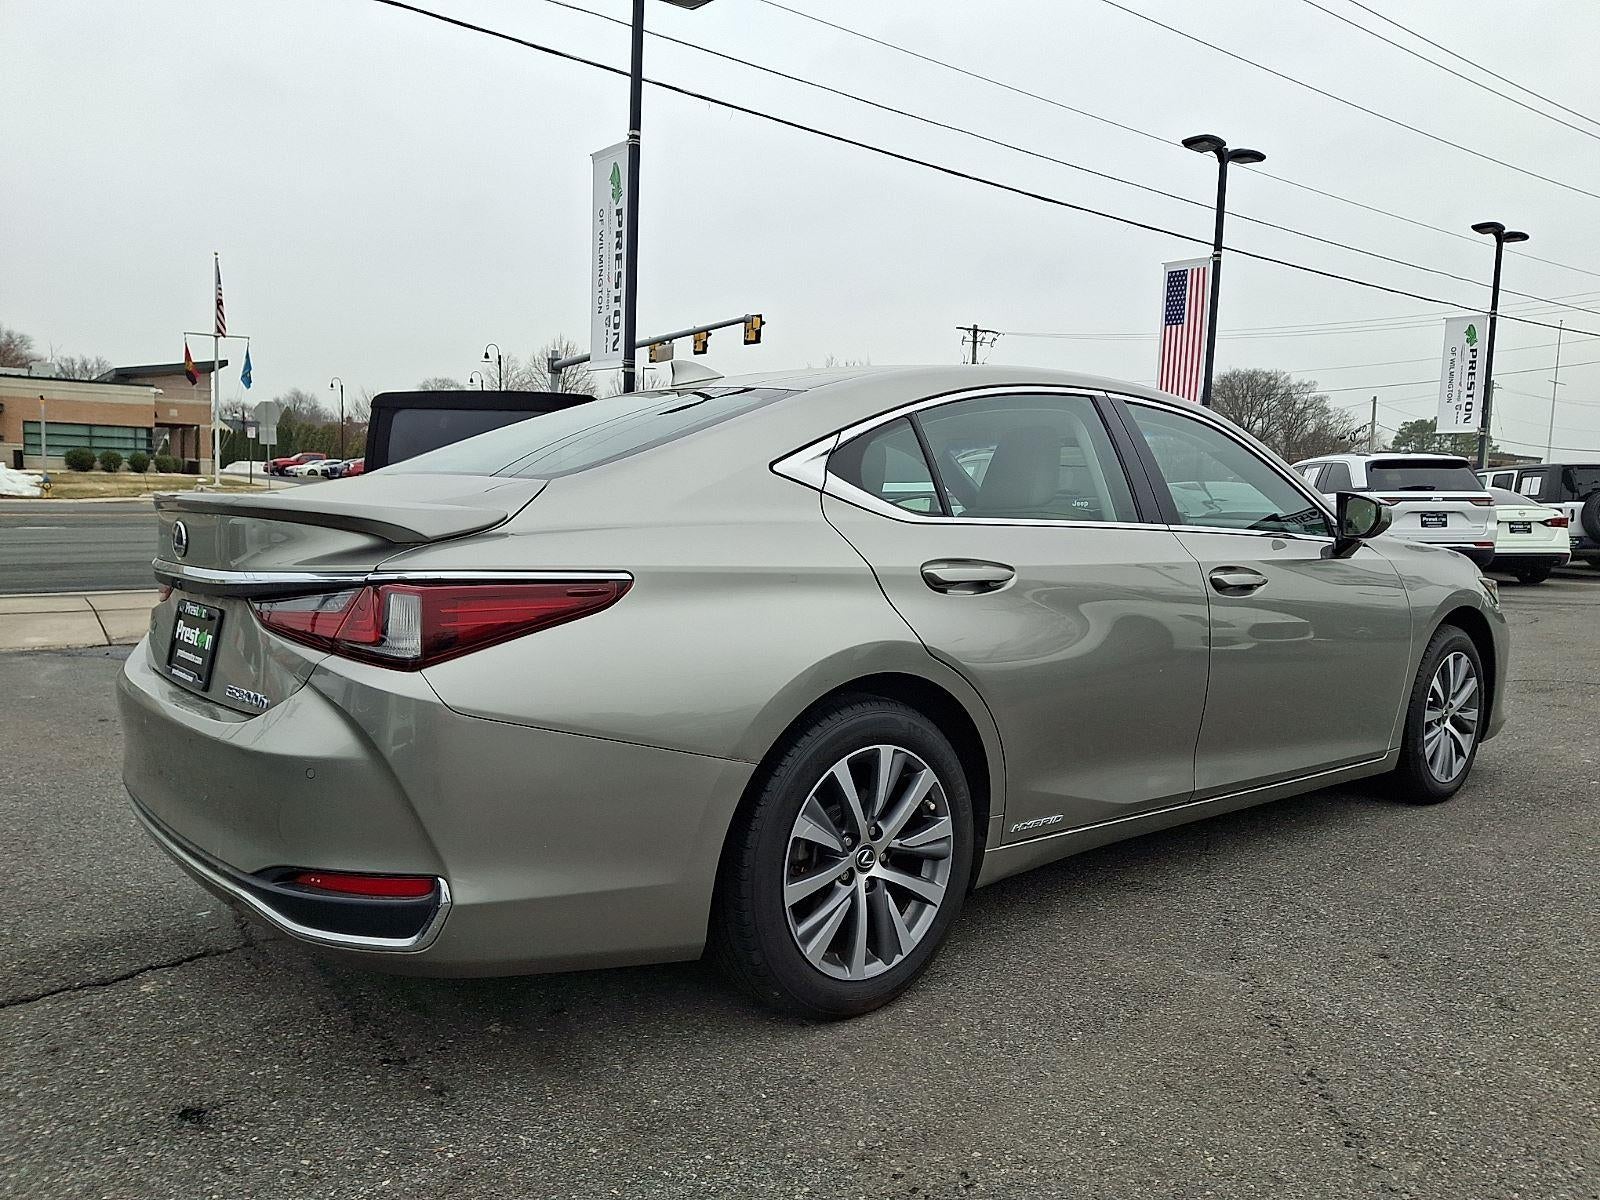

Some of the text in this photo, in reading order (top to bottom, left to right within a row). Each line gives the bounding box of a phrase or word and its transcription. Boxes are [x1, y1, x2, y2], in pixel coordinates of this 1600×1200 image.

[598, 208, 604, 225] OF
[612, 207, 623, 352] PRESTON
[1446, 346, 1457, 404] OF WILMINGTON
[1463, 348, 1478, 424] PRESTON
[1072, 500, 1089, 508] Jeep
[175, 619, 213, 651] Preston
[1010, 814, 1064, 833] HYBRID
